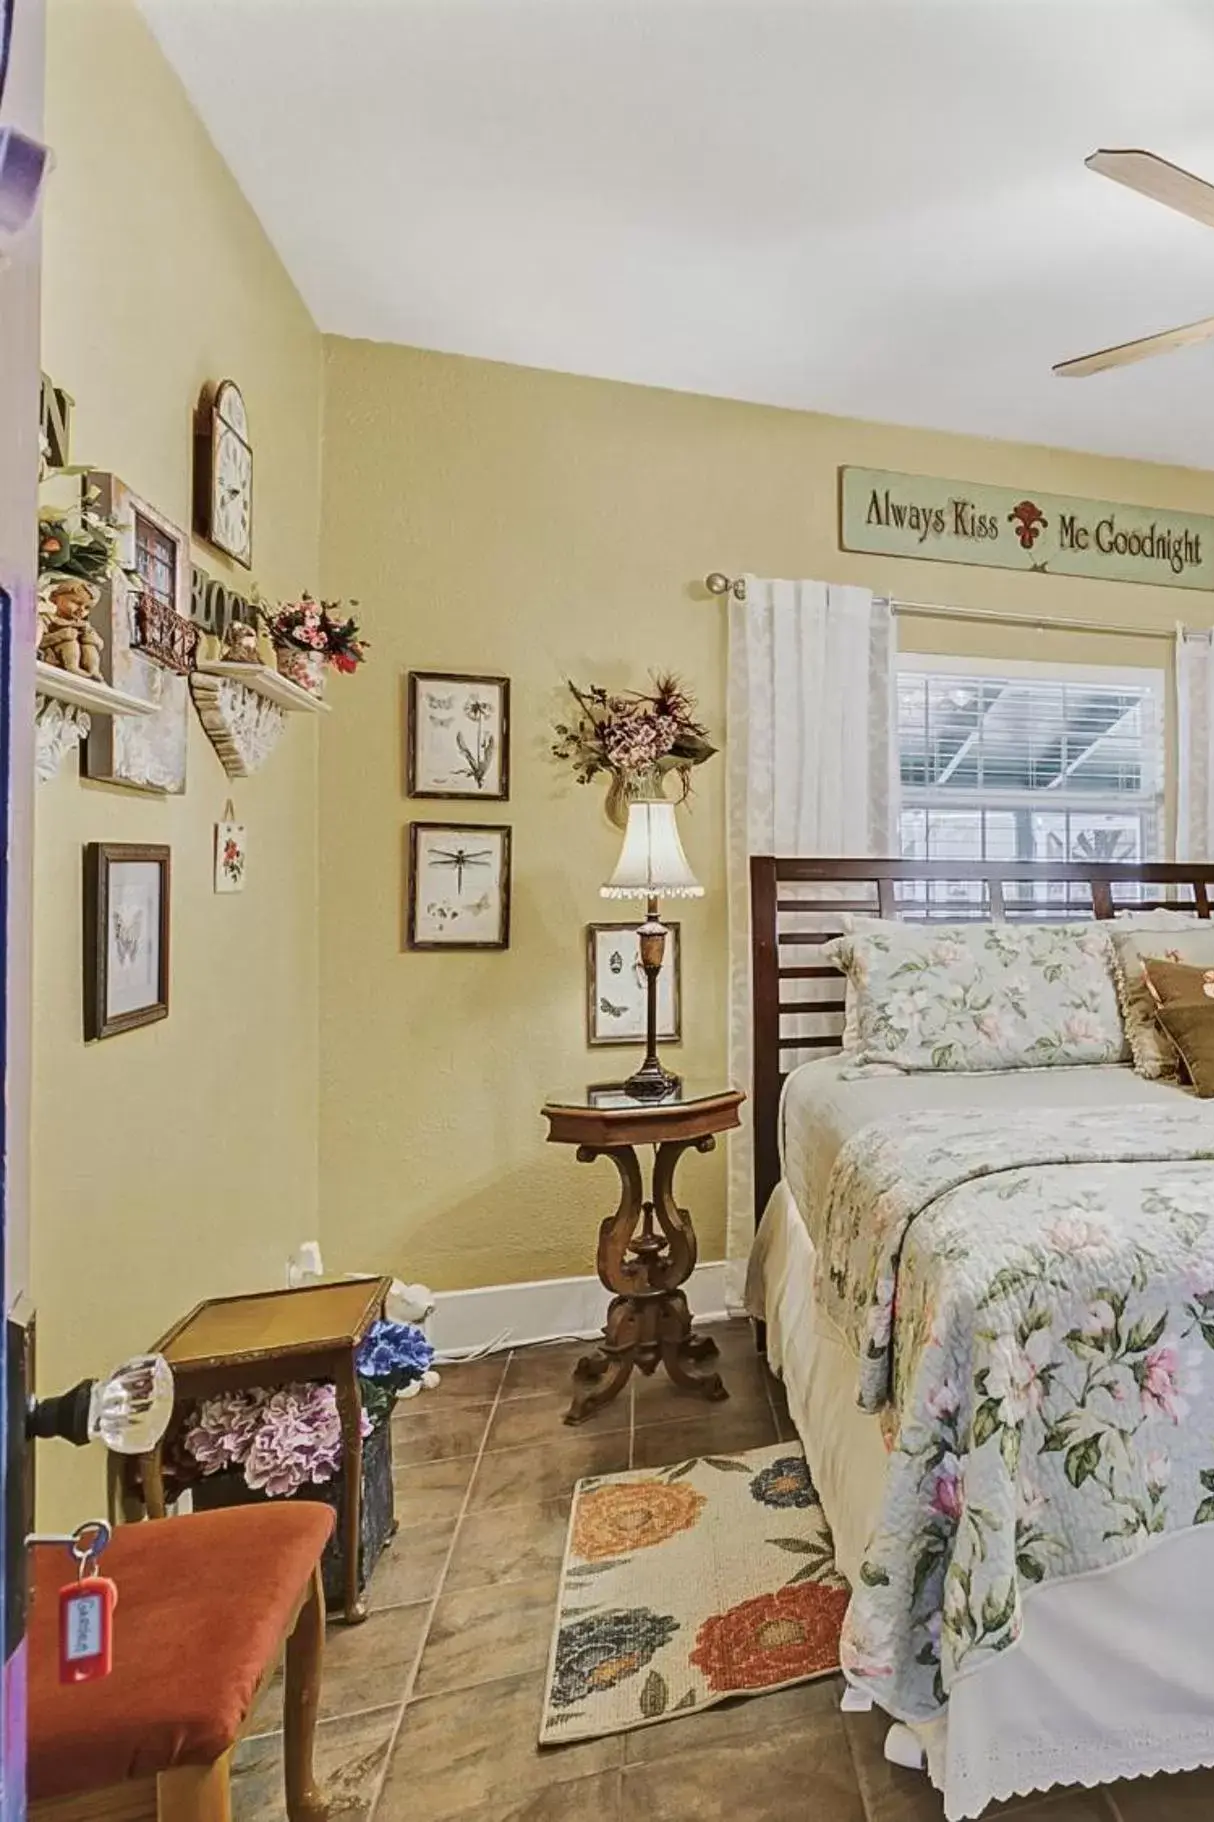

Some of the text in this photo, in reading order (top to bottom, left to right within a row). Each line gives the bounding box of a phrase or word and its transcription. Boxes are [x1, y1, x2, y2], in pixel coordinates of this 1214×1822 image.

[866, 488, 946, 545] Always
[952, 499, 999, 540] Kiss
[1095, 512, 1203, 574] Goodnight
